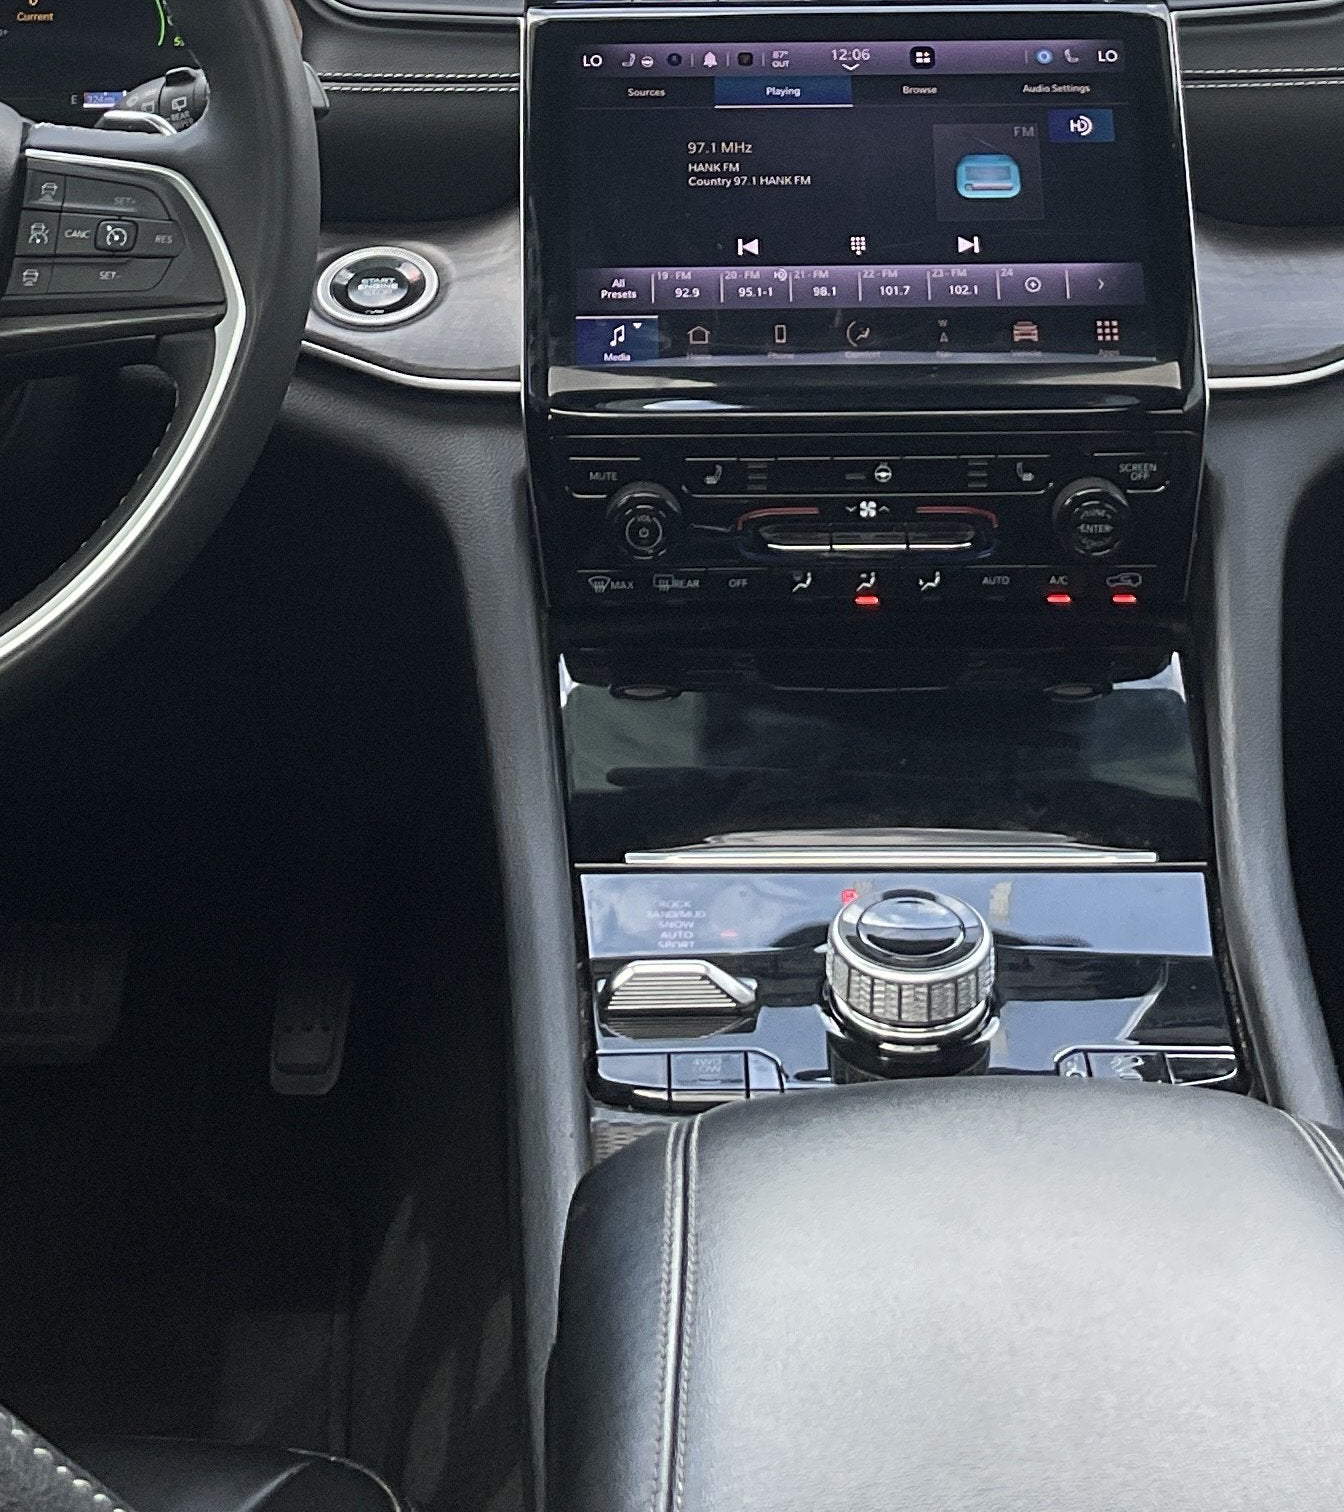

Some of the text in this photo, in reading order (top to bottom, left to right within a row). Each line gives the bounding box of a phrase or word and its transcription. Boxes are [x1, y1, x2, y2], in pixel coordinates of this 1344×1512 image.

[16, 12, 54, 22] Current
[831, 48, 870, 61] 12:06
[1097, 50, 1118, 63] LO
[582, 54, 603, 68] LO
[627, 88, 666, 97] Sources
[766, 86, 801, 98] Playing
[902, 85, 938, 95] Browse
[1022, 83, 1091, 95] Audio Settings
[1013, 126, 1035, 137] FM
[687, 141, 753, 154] 97.1 MHz
[688, 162, 740, 172] HANK FM
[688, 175, 812, 188] Country 97.1 HANK FM
[155, 234, 173, 244] RES
[612, 278, 625, 288] All
[600, 289, 637, 300] Presets
[675, 288, 700, 298] 92.9
[738, 287, 773, 298] 95.1-1
[813, 287, 837, 297] 98.1
[879, 285, 910, 296] 101.7
[949, 285, 978, 295] 102.1
[604, 352, 630, 362] Media
[1119, 463, 1157, 473] SCREEN
[589, 472, 618, 481] MUTE
[1130, 471, 1150, 481] OFF
[611, 580, 634, 589] MAX
[729, 578, 748, 588] OFF
[983, 575, 1010, 585] AUTO
[1049, 575, 1068, 585] A/C
[659, 930, 694, 939] AUTO
